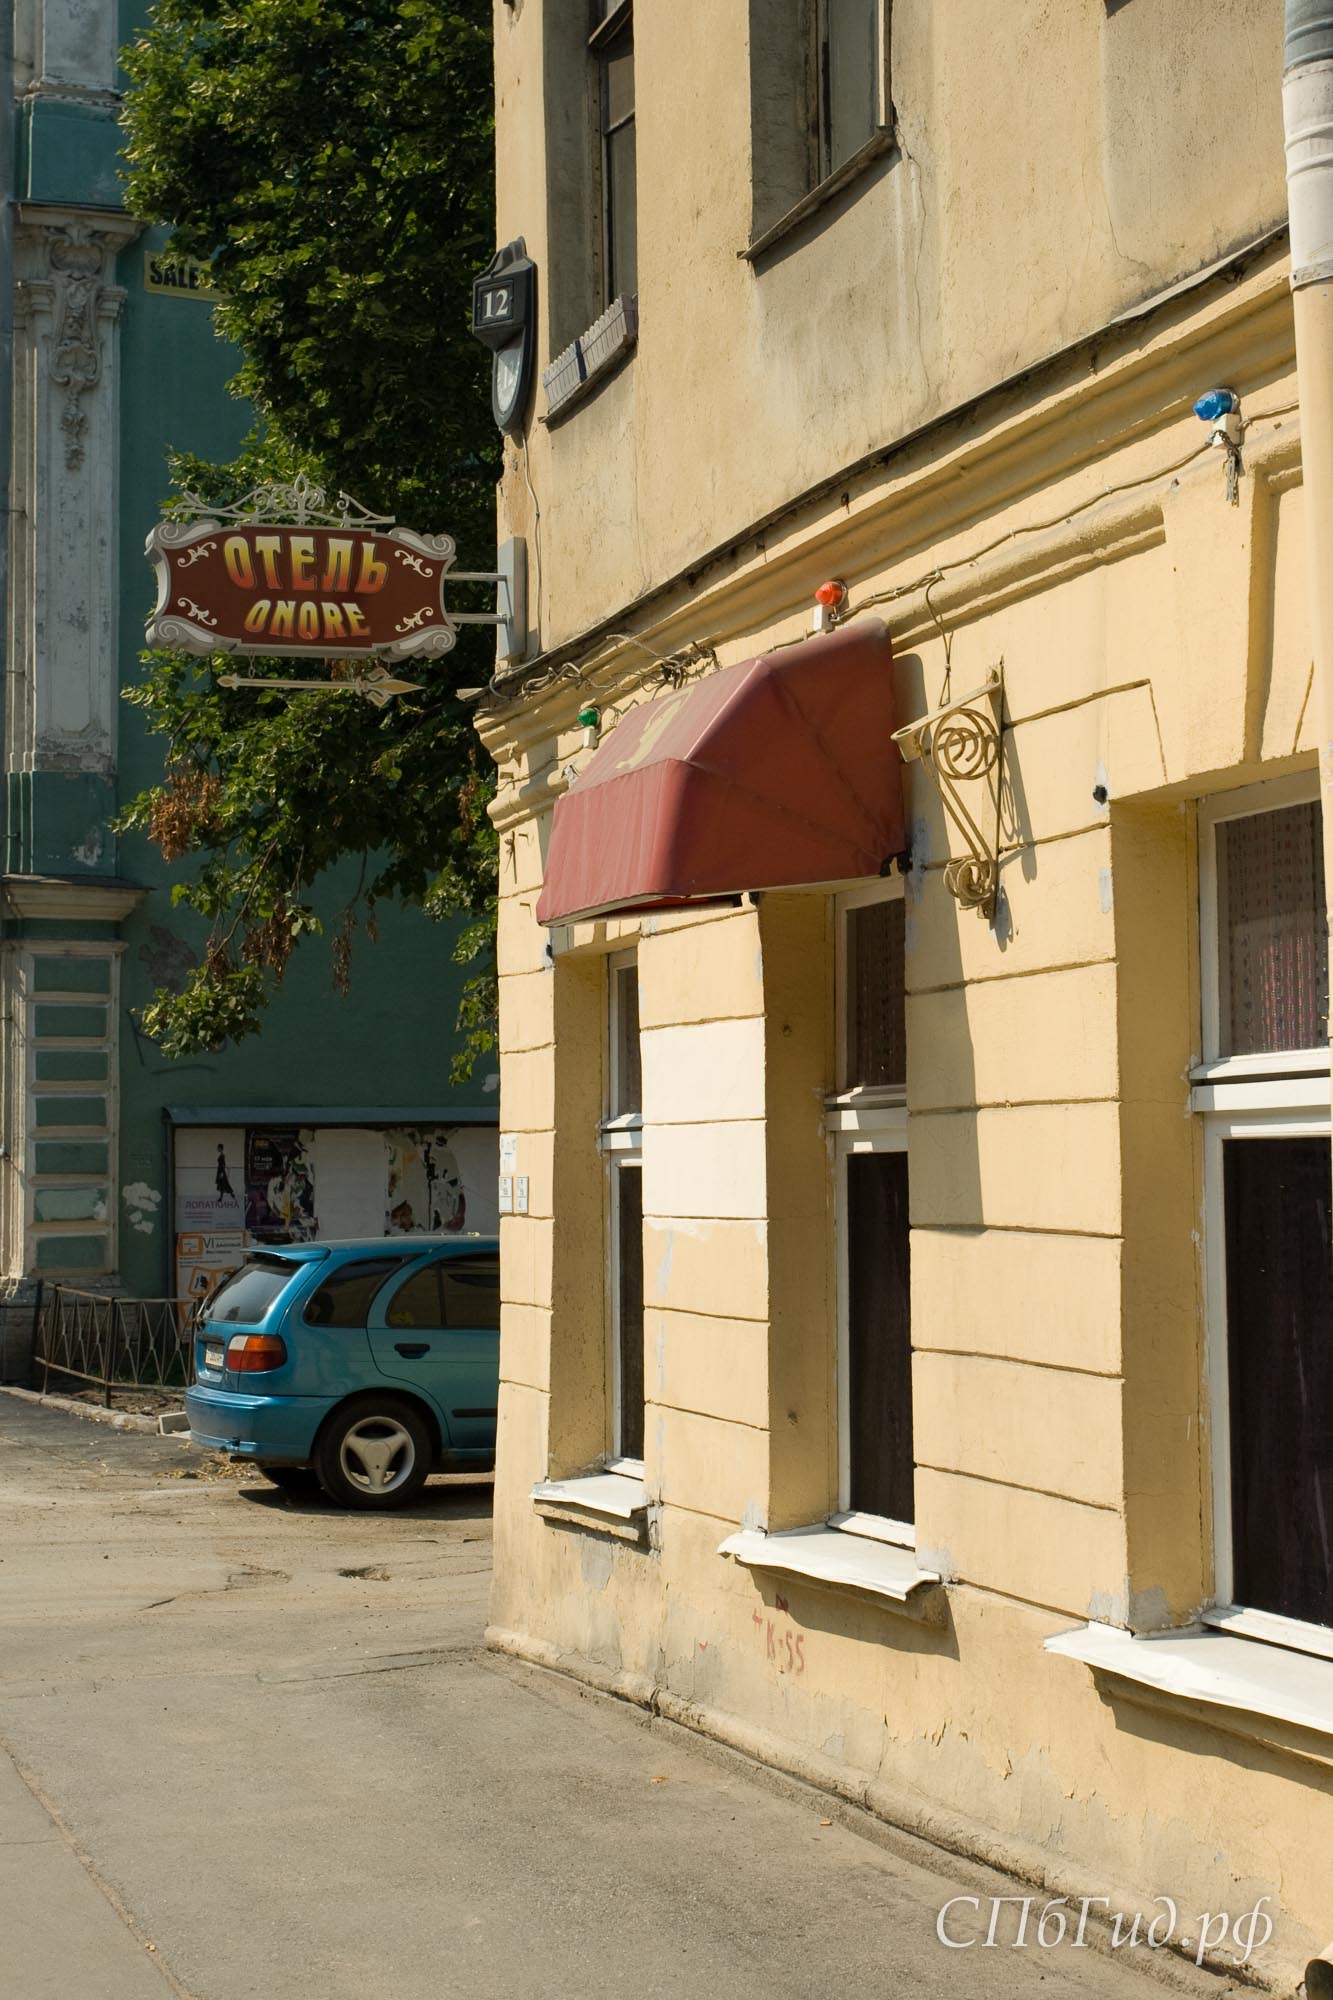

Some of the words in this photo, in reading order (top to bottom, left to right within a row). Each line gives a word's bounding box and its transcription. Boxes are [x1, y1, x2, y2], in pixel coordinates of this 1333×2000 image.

[150, 260, 199, 290] SALE
[482, 289, 509, 319] 12
[223, 535, 390, 594] ОТЕЛЬ
[244, 599, 371, 640] ONORE
[185, 1200, 240, 1209] ЛОПАТКИНА
